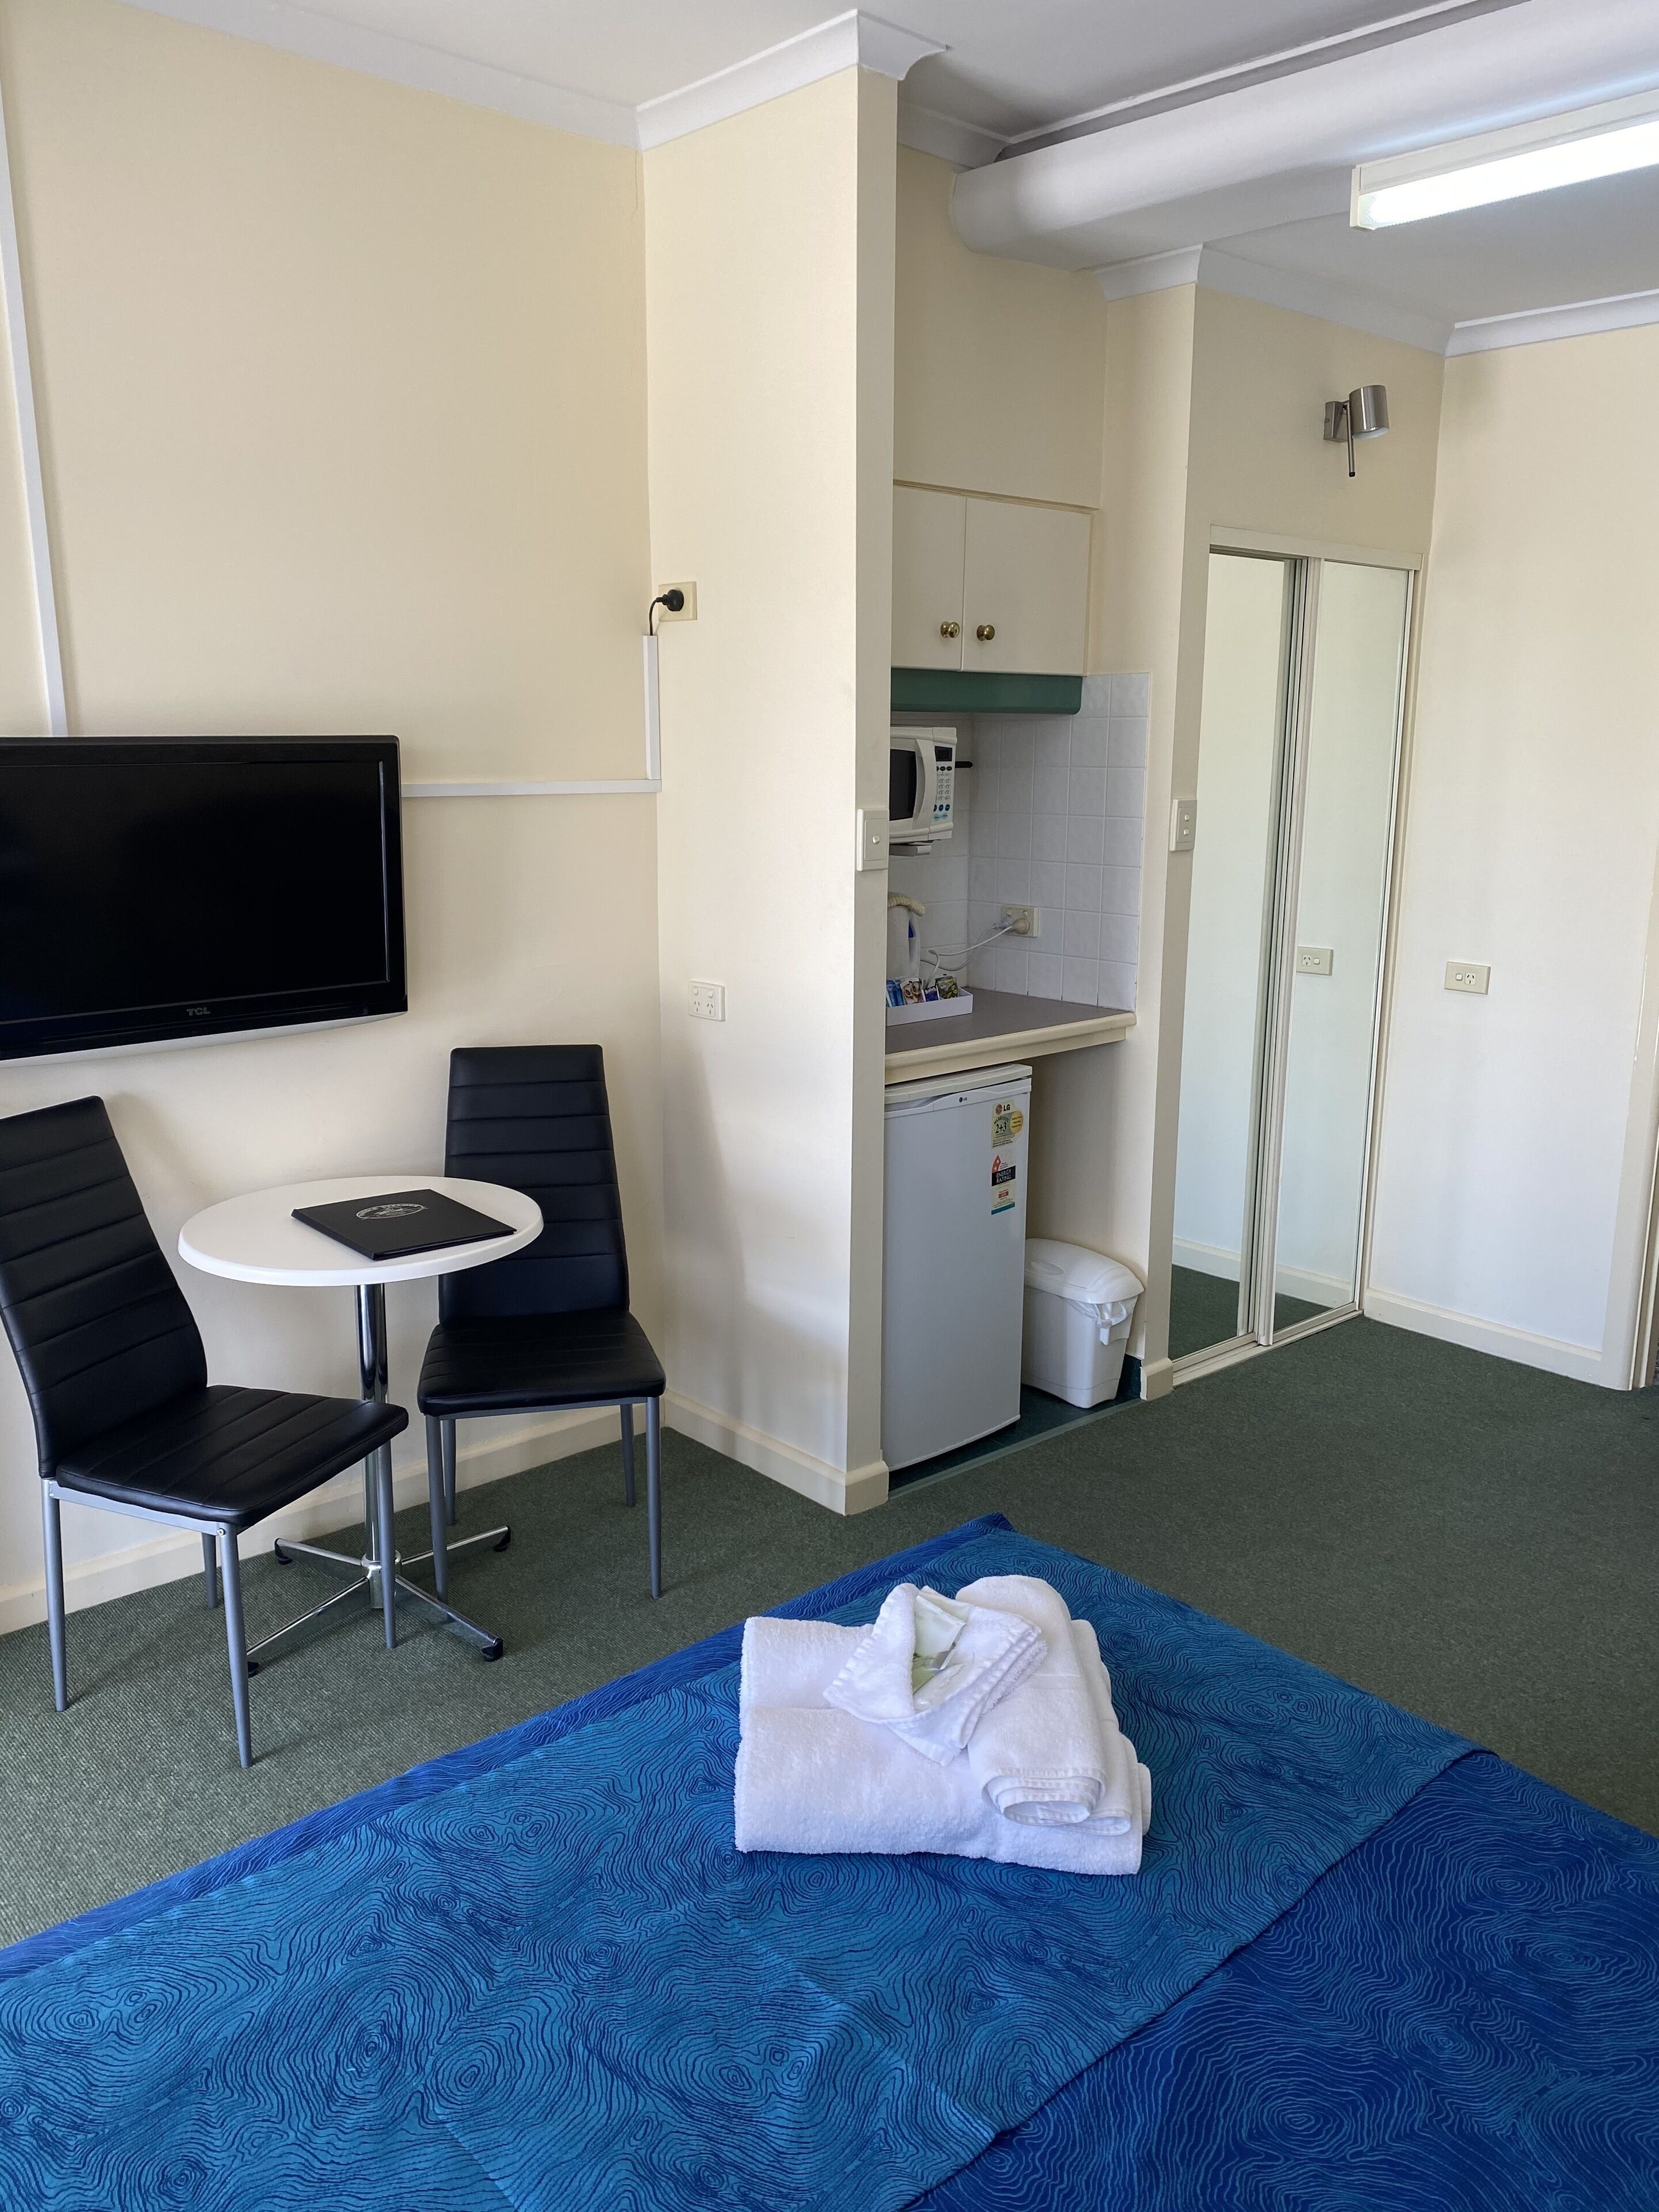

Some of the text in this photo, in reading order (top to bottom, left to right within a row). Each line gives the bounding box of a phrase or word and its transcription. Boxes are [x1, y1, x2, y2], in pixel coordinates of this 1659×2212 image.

[186, 1007, 211, 1016] TCL
[995, 1122, 1007, 1134] 2+3
[996, 1168, 1012, 1179] ENERGY
[996, 1175, 1012, 1184] RATING
